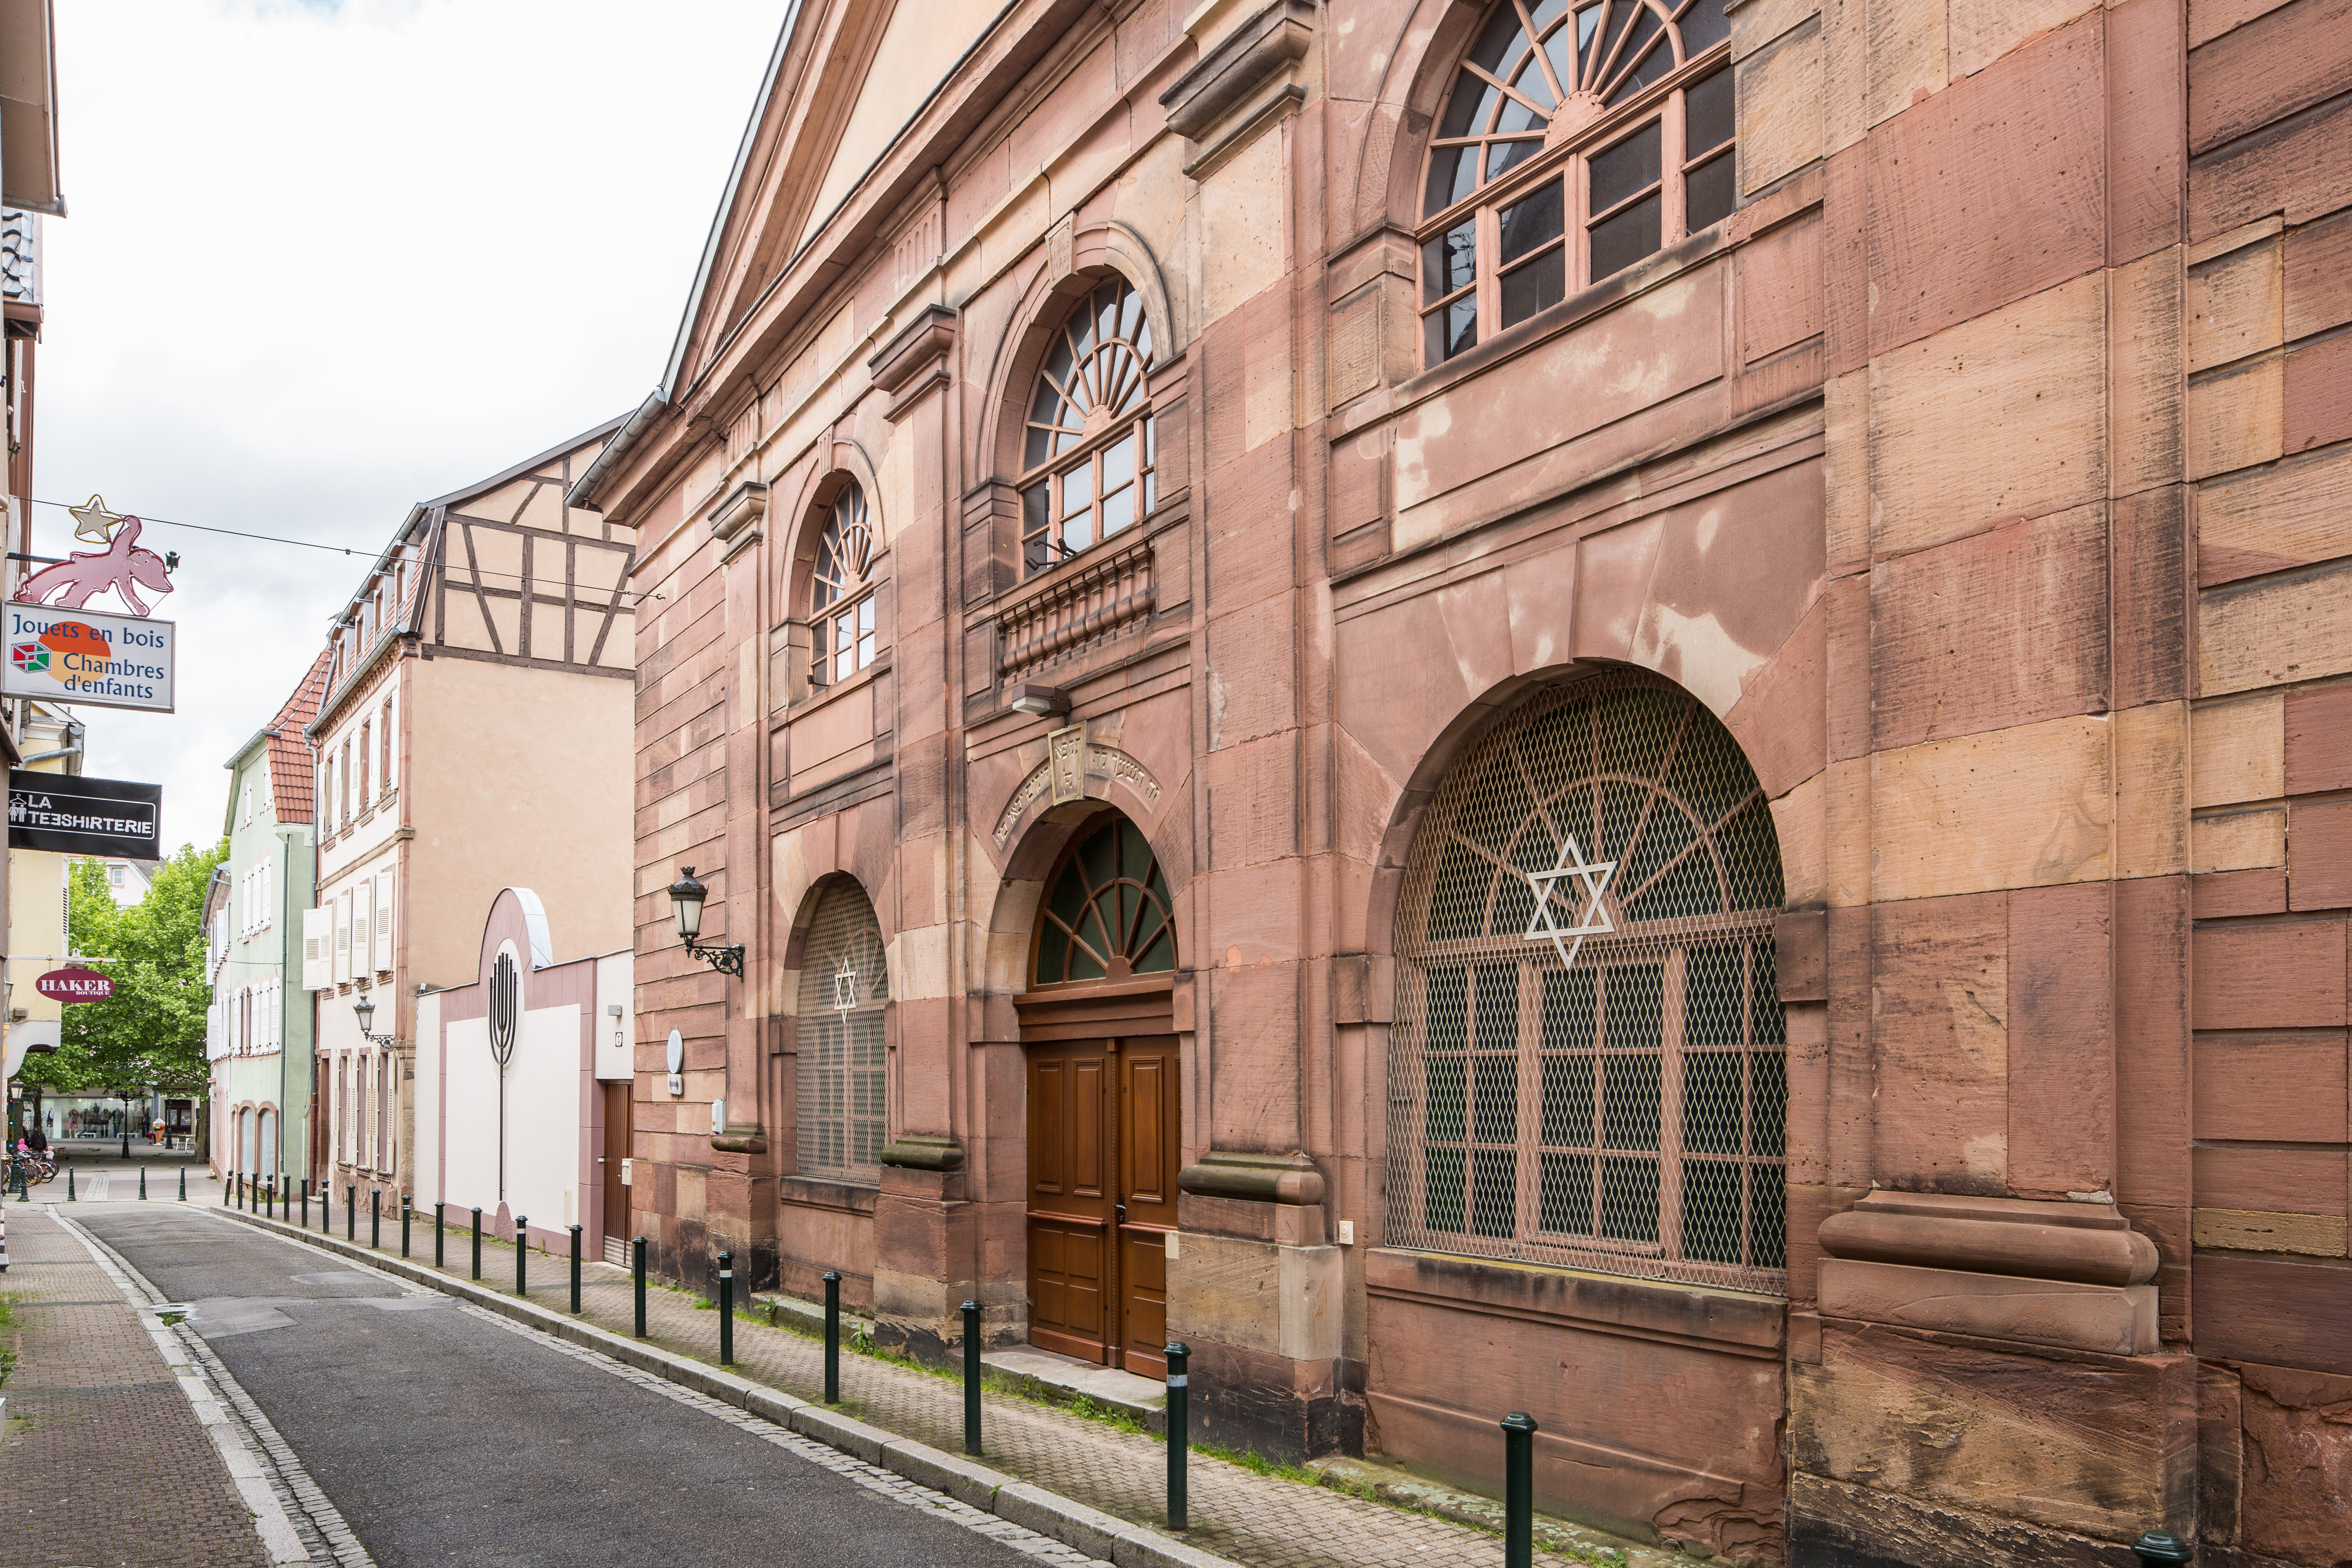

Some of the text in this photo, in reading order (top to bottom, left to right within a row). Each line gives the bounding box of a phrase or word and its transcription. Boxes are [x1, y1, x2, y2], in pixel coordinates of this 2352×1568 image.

[13, 614, 164, 648] Jouets en bois
[63, 653, 164, 679] Chambres
[64, 674, 153, 698] d'enfants
[1112, 752, 1145, 789] השער
[28, 794, 52, 809] LA
[1145, 778, 1160, 802] זה
[28, 811, 153, 834] TEESHIRTERIE
[40, 980, 111, 991] HAKER
